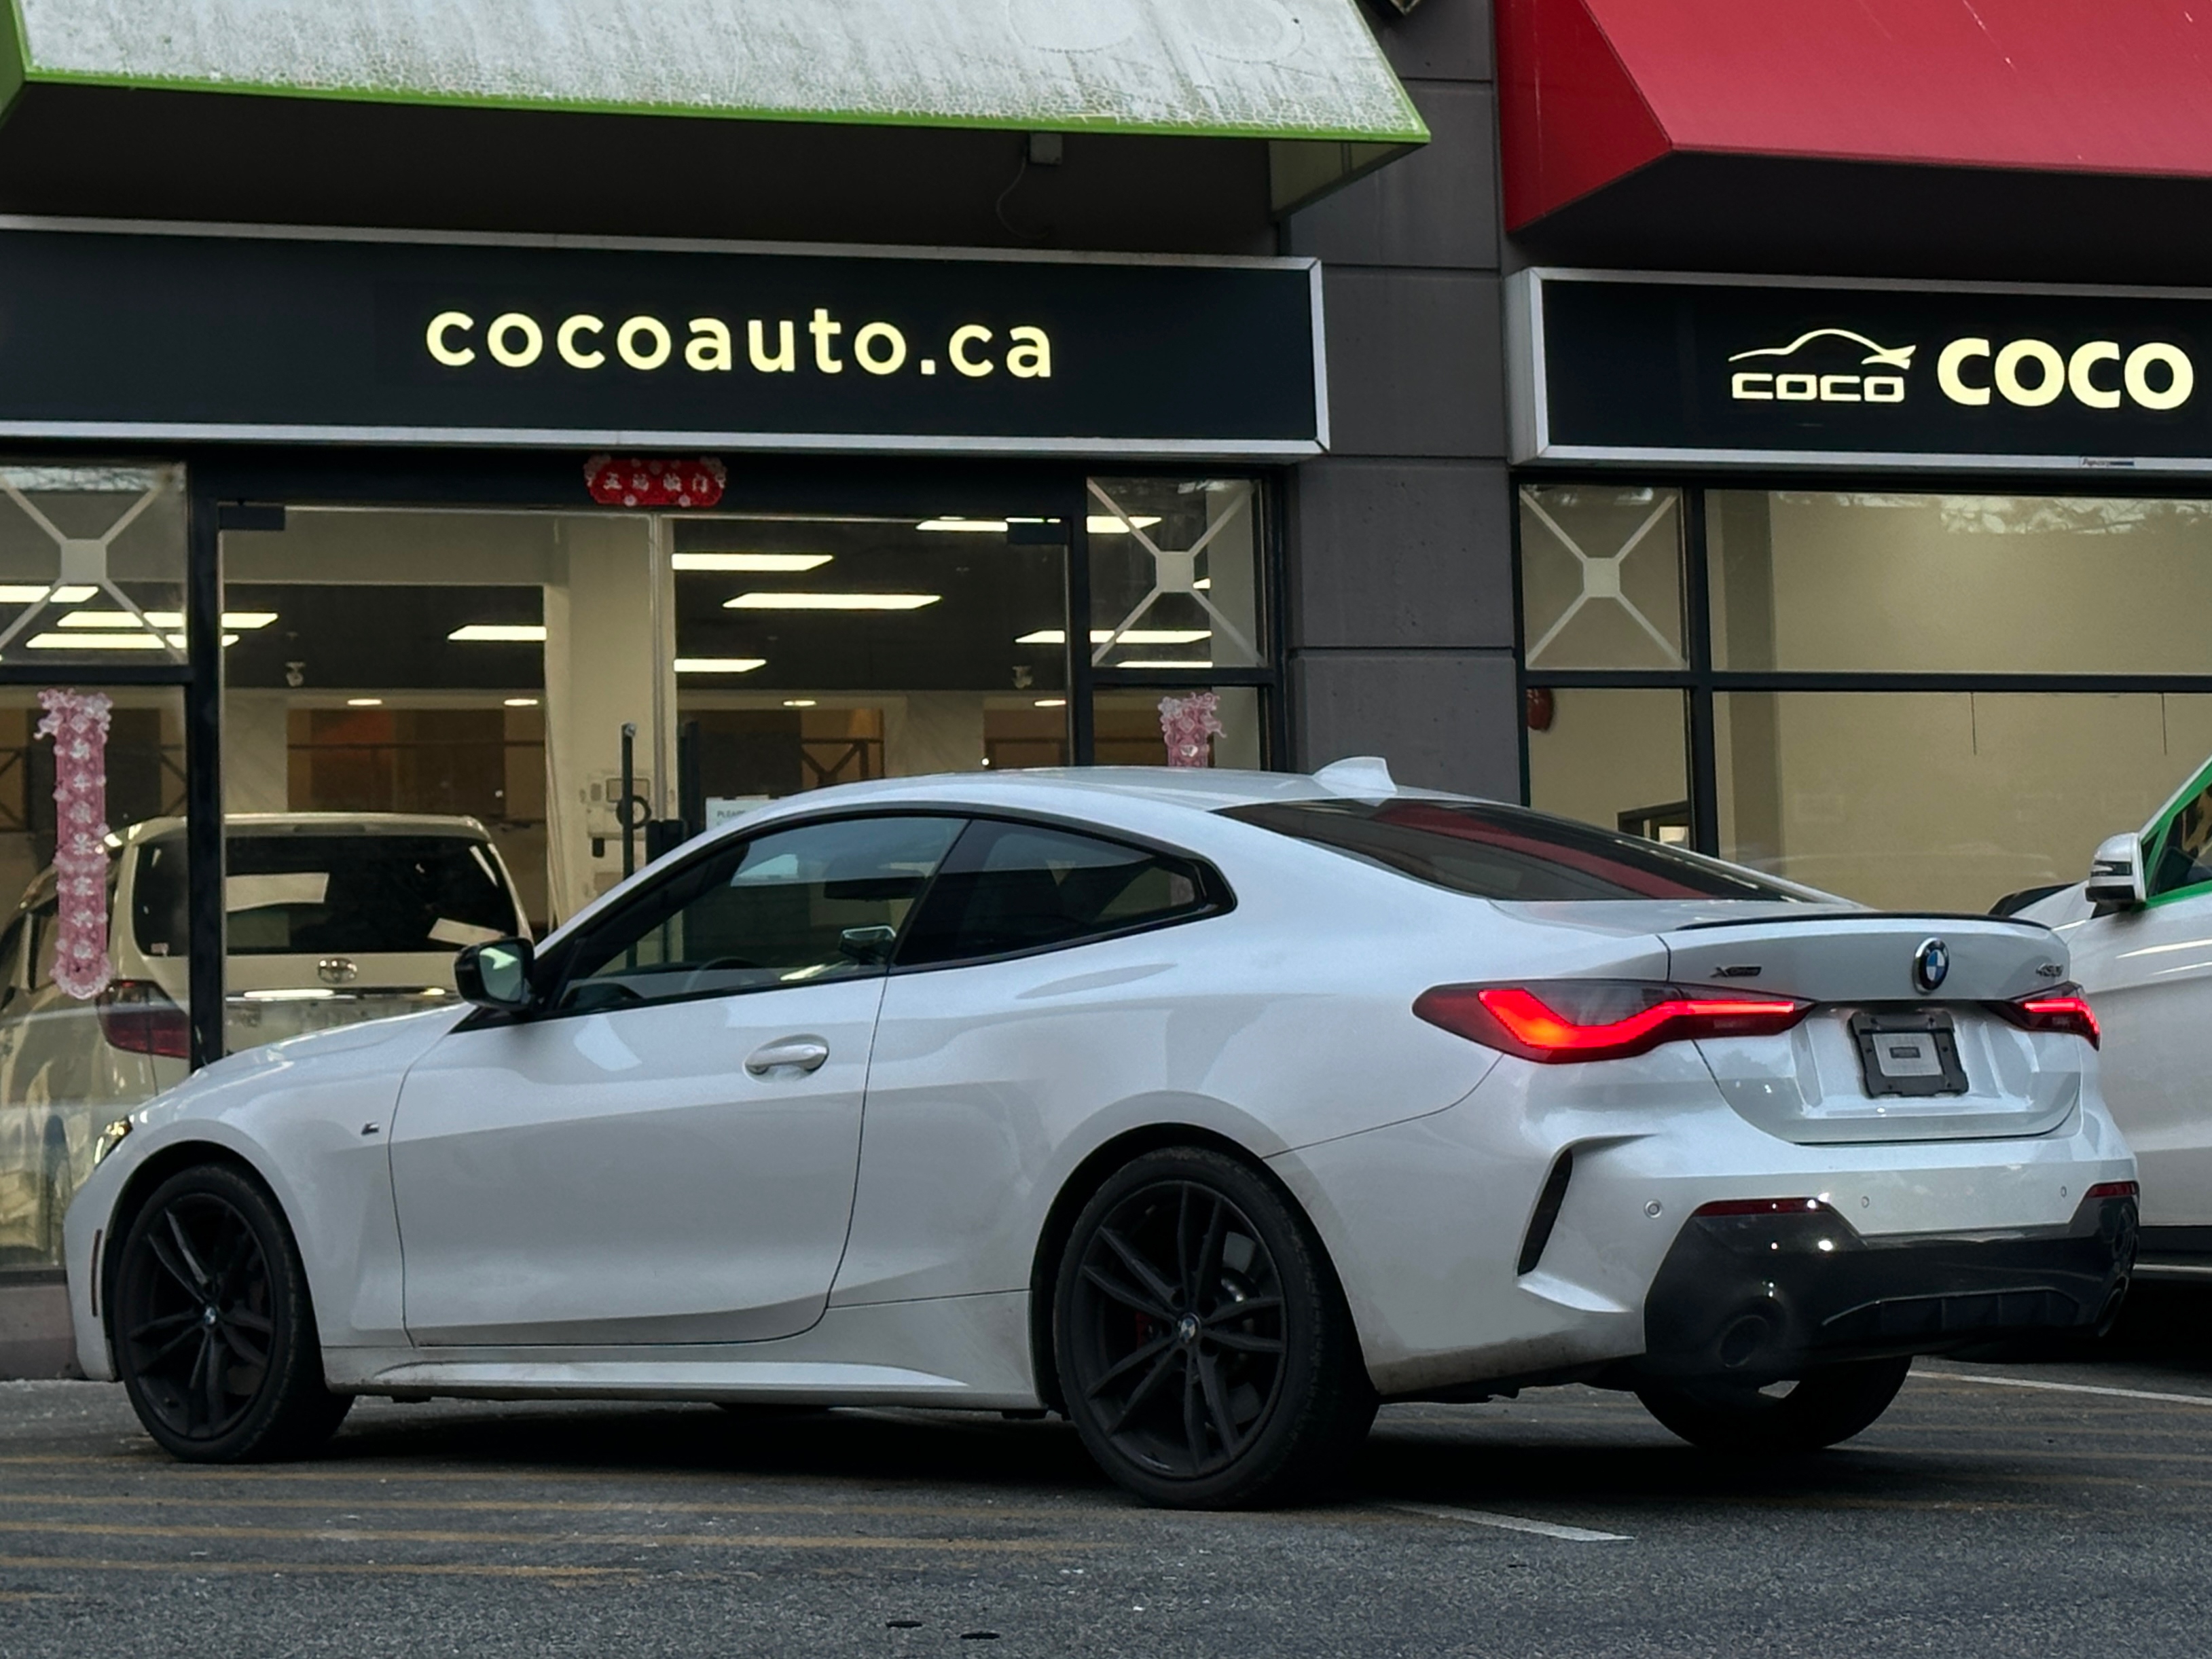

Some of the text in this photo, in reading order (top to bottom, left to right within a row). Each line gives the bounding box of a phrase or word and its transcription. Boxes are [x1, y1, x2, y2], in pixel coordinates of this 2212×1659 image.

[427, 308, 1051, 378] cocoauto.ca
[1937, 338, 2194, 410] COCO
[1731, 372, 1905, 403] COCO
